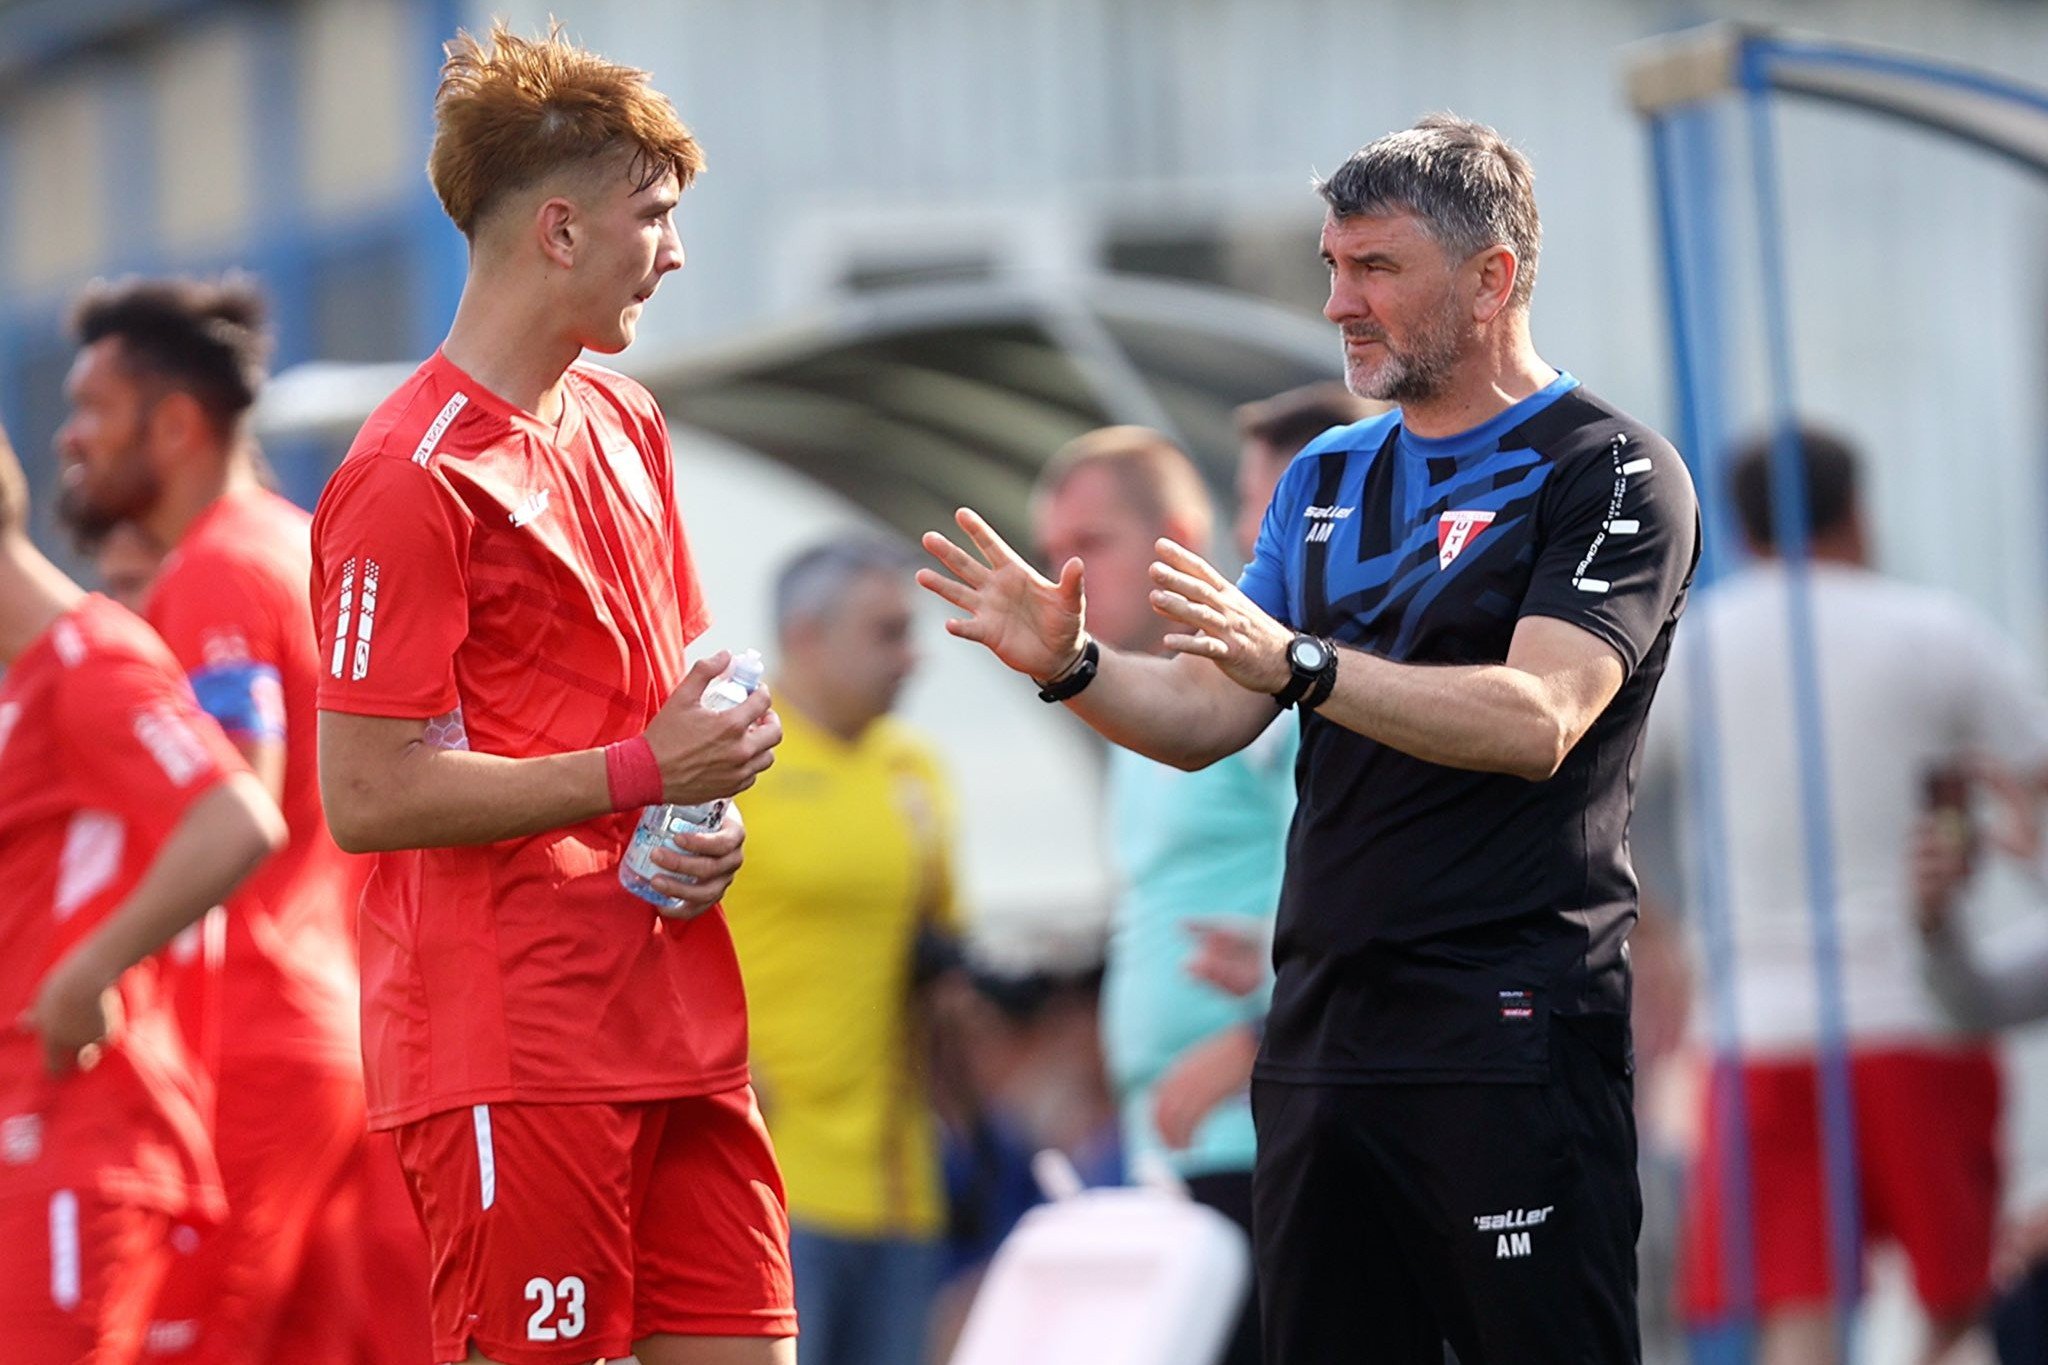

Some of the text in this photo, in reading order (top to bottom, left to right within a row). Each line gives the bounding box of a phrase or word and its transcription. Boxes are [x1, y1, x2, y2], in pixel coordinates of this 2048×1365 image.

[1304, 521, 1336, 542] AM
[1496, 1231, 1532, 1259] AM
[524, 1275, 586, 1342] 23
